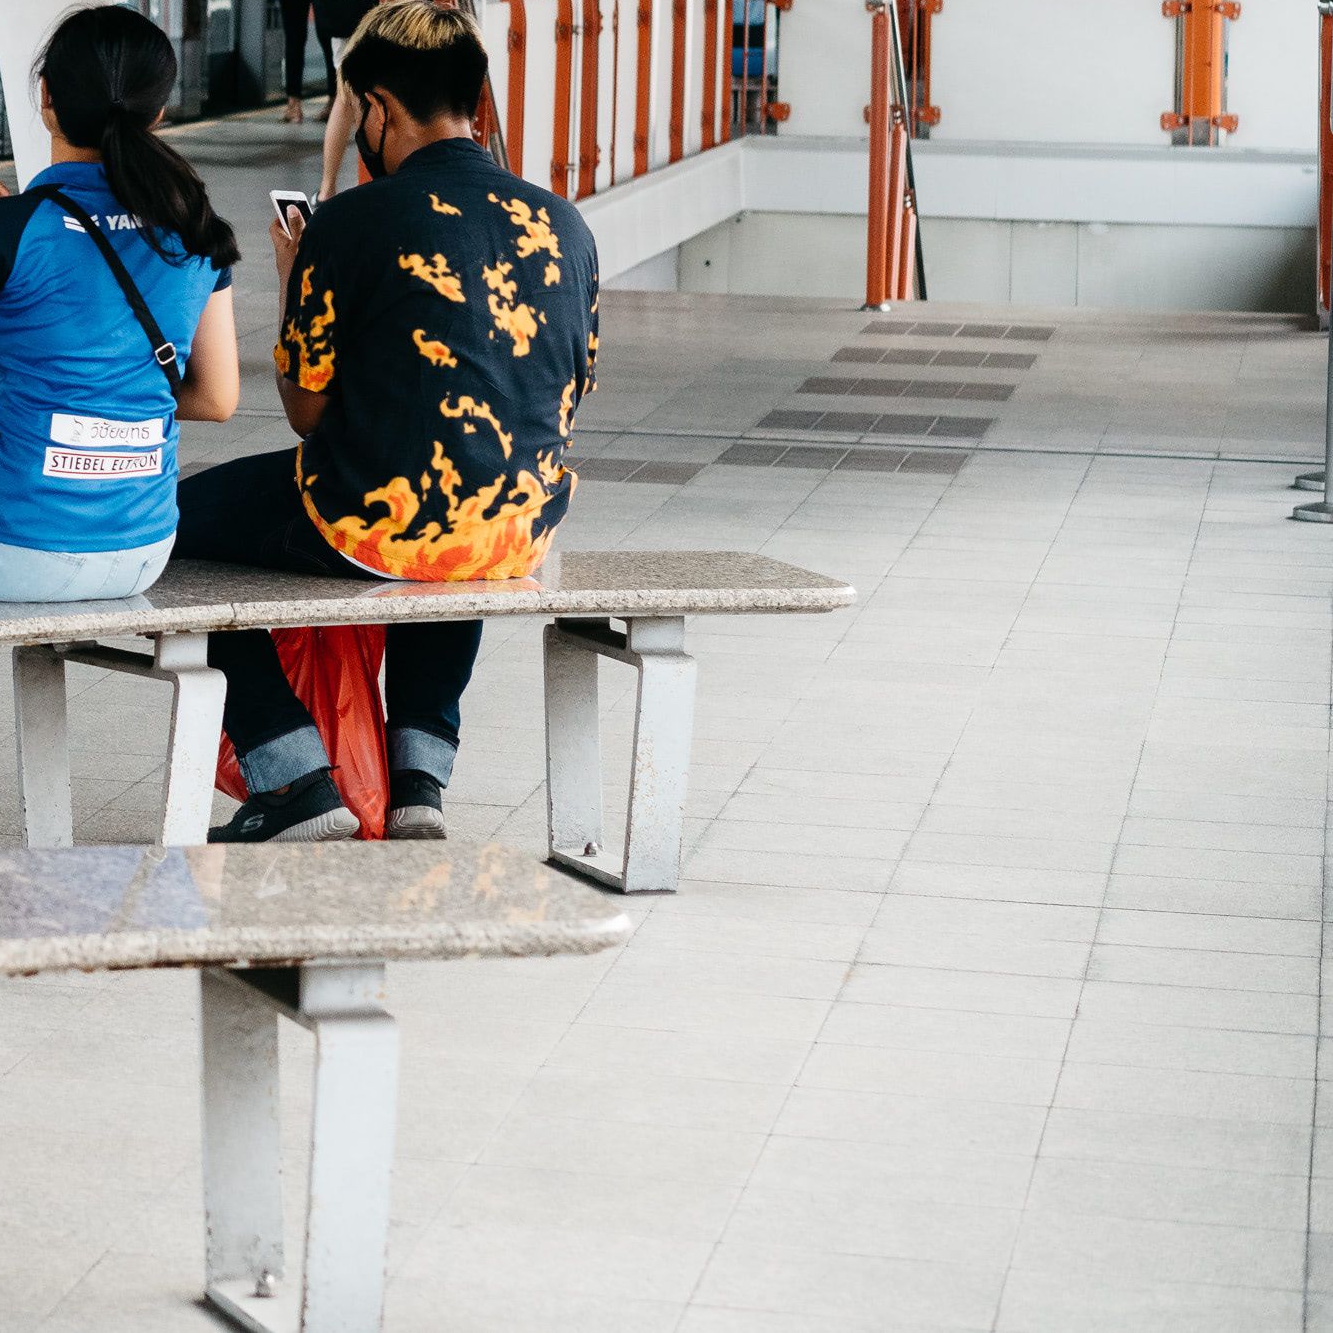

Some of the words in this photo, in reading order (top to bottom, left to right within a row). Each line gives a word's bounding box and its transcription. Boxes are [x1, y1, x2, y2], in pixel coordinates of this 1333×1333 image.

[90, 421, 150, 444] วิชัยยุทธ
[51, 455, 105, 471] STIEBEL
[111, 453, 158, 471] ELTRON
